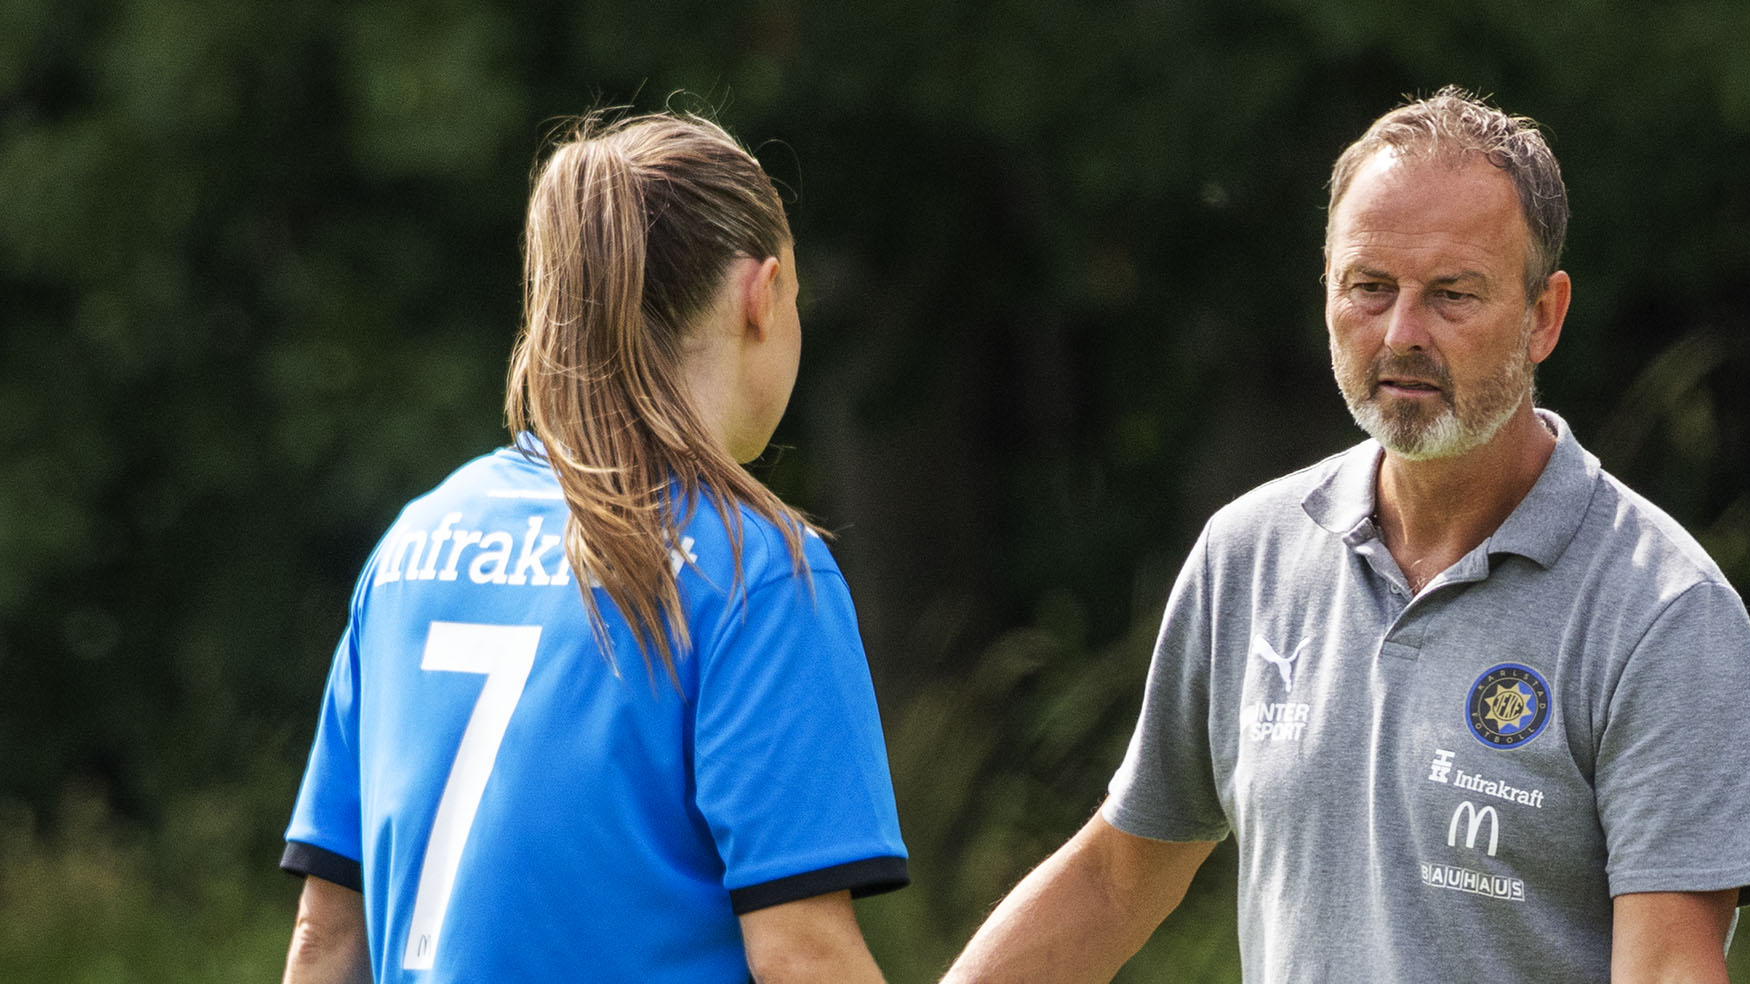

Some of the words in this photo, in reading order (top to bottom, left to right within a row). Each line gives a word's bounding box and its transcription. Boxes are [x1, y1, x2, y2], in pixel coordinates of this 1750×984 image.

[1477, 669, 1547, 710] KARLSTAD
[1471, 711, 1535, 744] FOTBOLL
[403, 621, 542, 970] 7
[1453, 769, 1544, 808] Infrakraft
[1420, 863, 1524, 899] BAUHAUS
